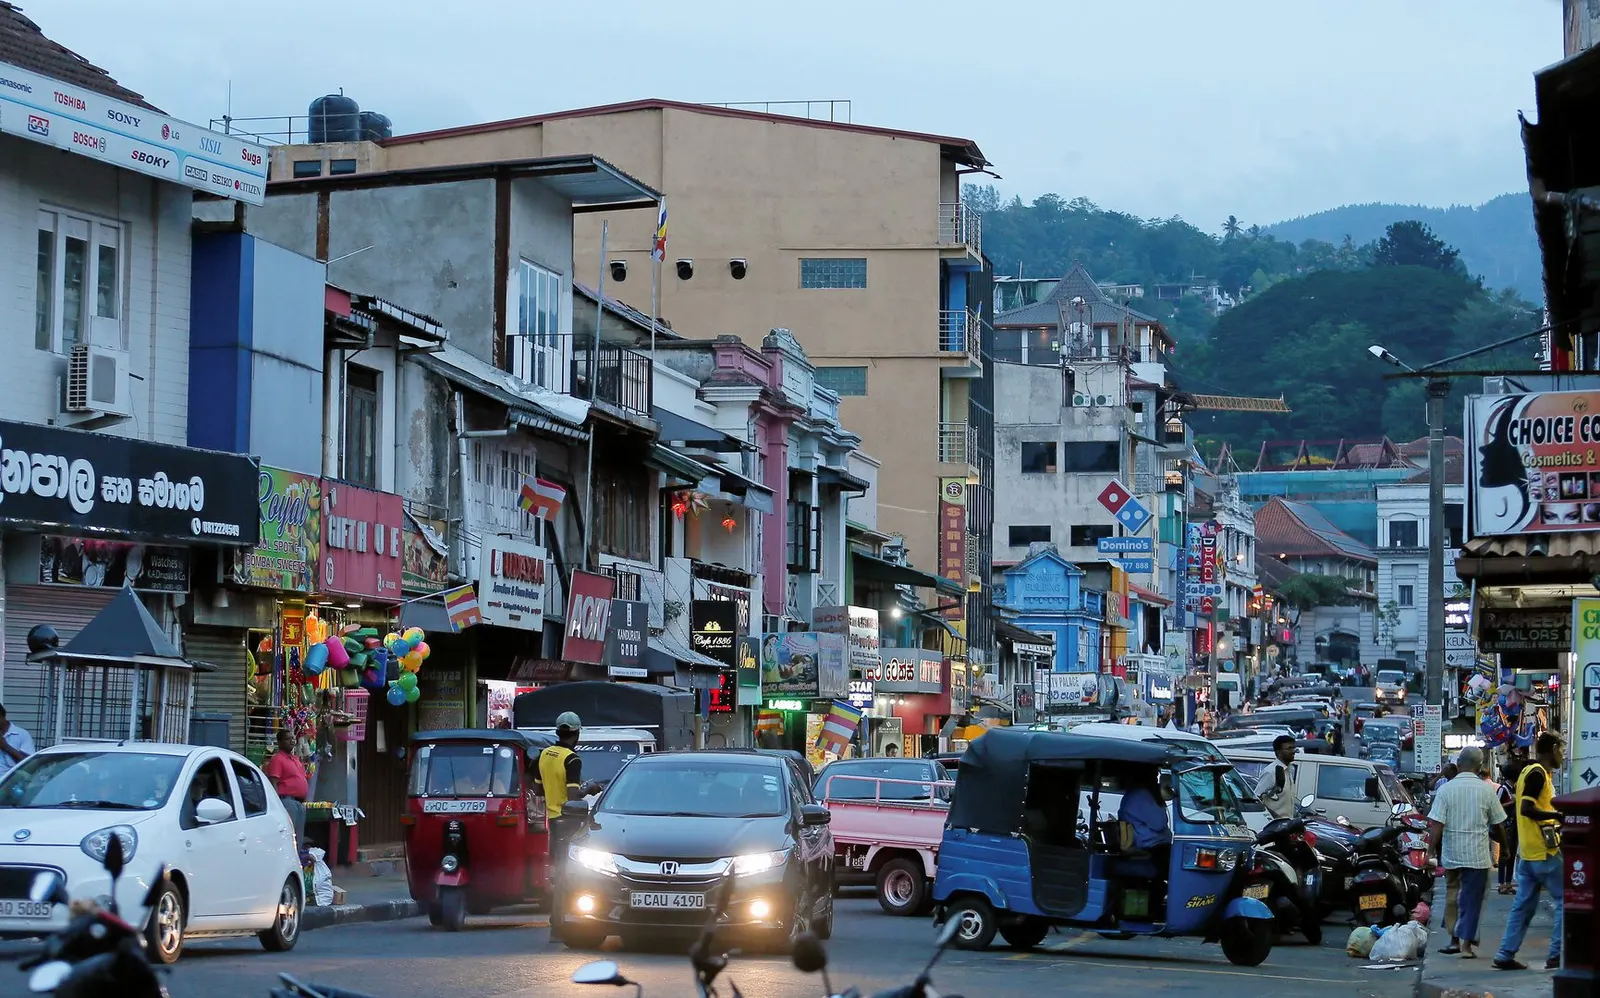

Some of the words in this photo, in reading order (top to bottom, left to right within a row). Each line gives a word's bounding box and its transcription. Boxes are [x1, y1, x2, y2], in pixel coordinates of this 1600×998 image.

[53, 91, 87, 111] TOSHIBA
[107, 109, 141, 128] SONY
[73, 131, 99, 150] BOSCH
[171, 131, 180, 141] LG
[199, 136, 222, 156] SISIL
[131, 150, 170, 169] SBOKY
[241, 148, 262, 166] Suga
[186, 166, 208, 182] CASIO
[211, 173, 233, 188] SEIKO
[239, 181, 262, 196] CITIZEN
[1508, 415, 1575, 447] CHOICE
[1521, 450, 1583, 468] Cosmetics
[1586, 448, 1597, 465] &
[0, 447, 96, 514] නපාල
[101, 475, 133, 504] සහ
[138, 471, 205, 512] සමාගම
[259, 470, 310, 537] Royal
[1100, 540, 1149, 550] Domino's
[246, 553, 279, 570] BOMBAY
[281, 558, 307, 574] SWEETS
[712, 636, 732, 645] 1886
[1498, 629, 1560, 641] TAILORS
[849, 681, 873, 693] STAR
[435, 801, 448, 811] QC
[18, 901, 50, 916] 5085
[644, 894, 668, 907] CAU
[673, 895, 703, 908] 4190
